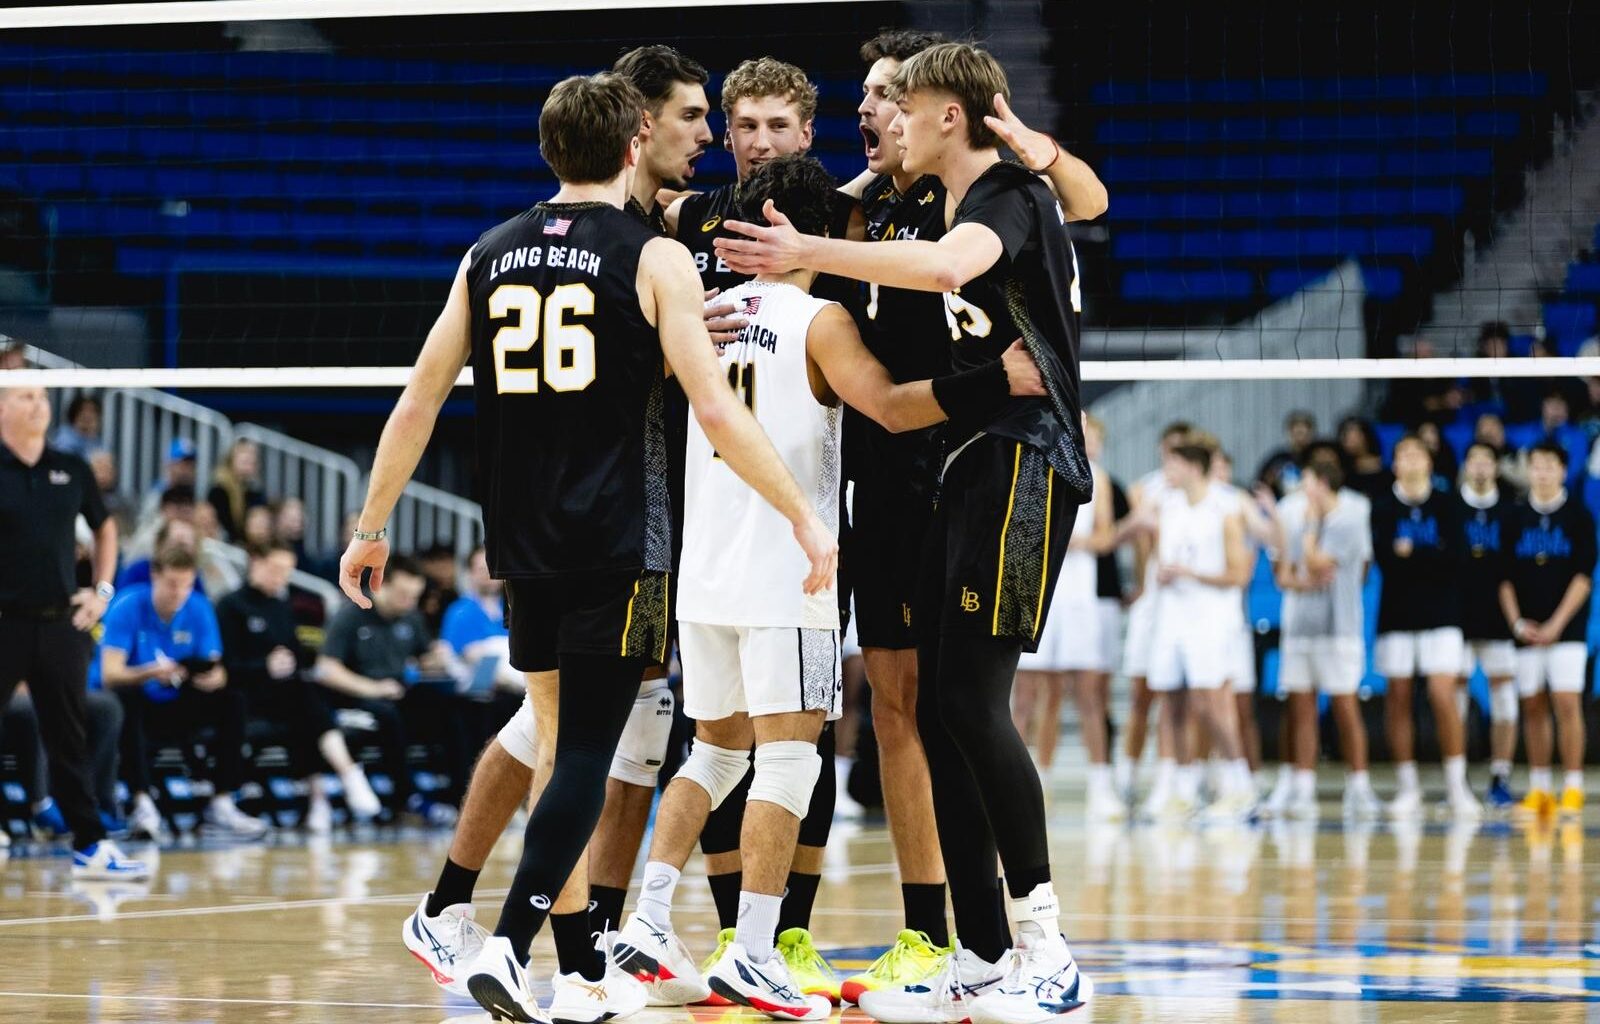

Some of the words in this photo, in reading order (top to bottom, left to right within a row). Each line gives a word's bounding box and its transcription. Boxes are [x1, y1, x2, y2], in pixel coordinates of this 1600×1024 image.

[490, 246, 542, 281] LONG
[547, 245, 601, 277] BEACH
[488, 282, 596, 395] 26
